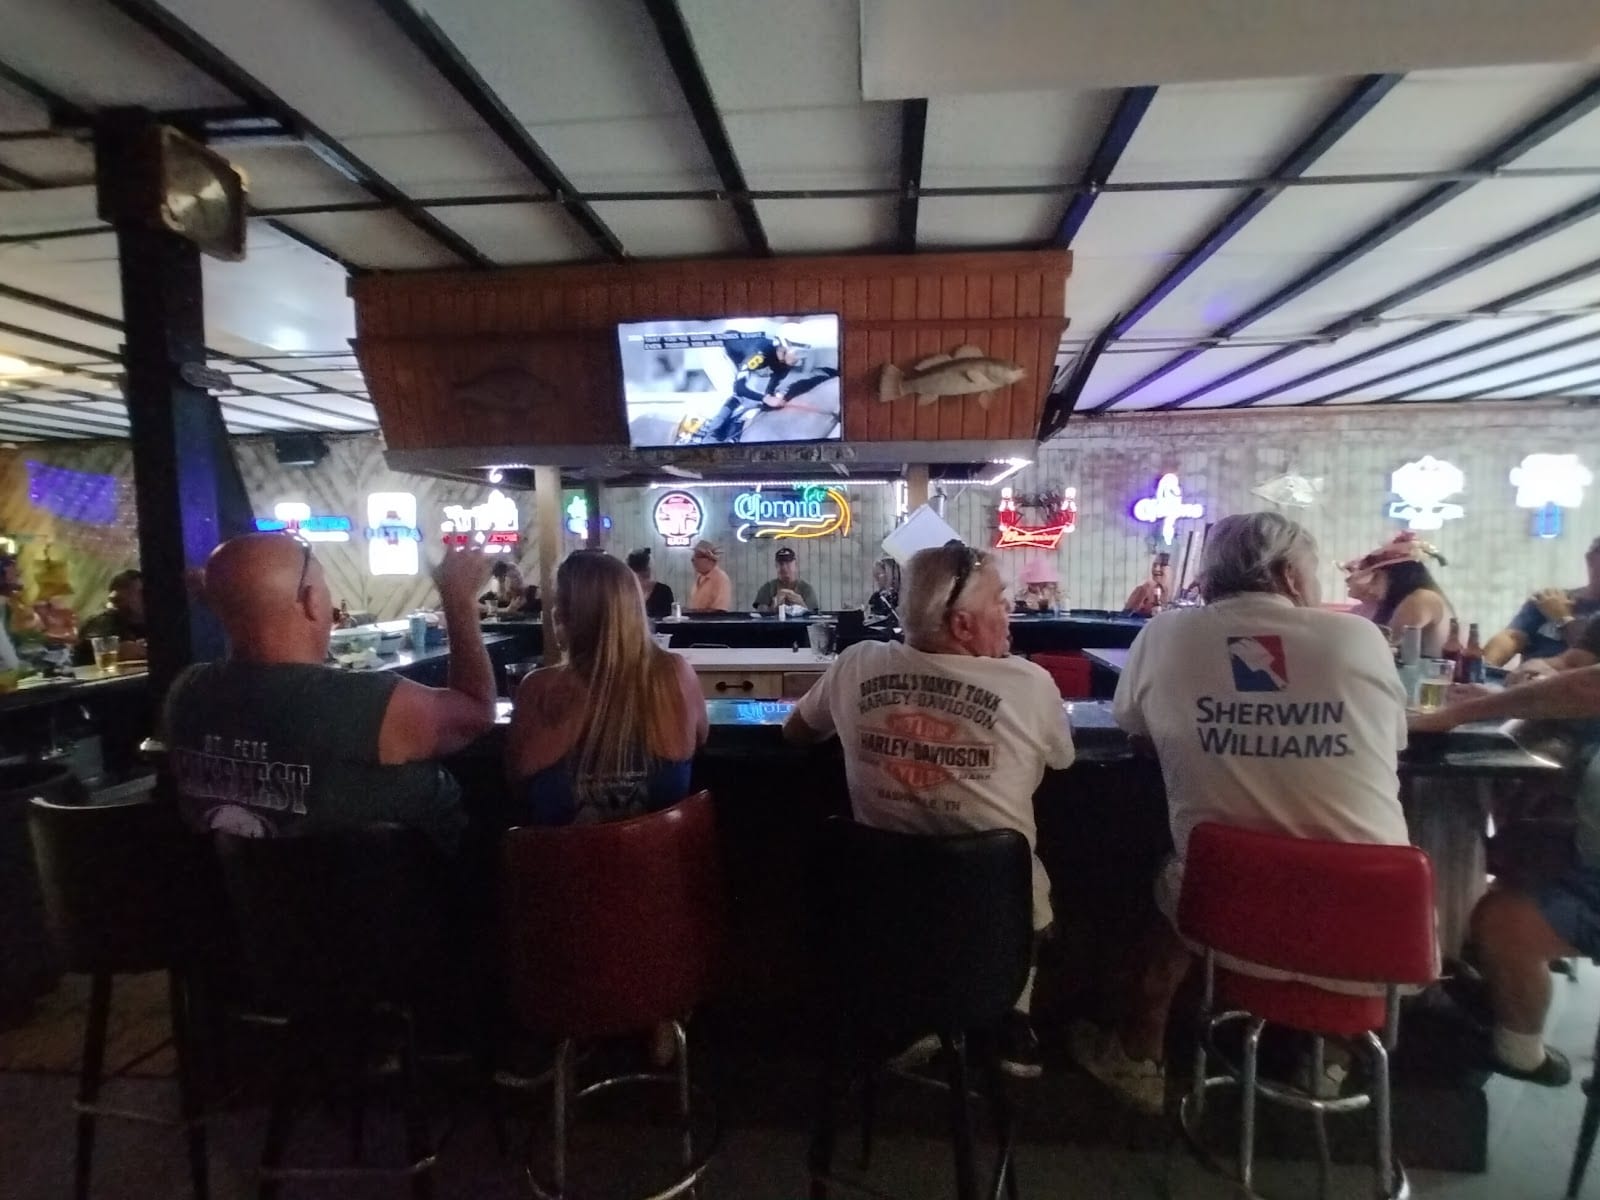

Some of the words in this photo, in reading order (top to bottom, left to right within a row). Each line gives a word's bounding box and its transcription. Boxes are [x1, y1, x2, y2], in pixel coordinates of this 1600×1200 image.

[735, 493, 821, 521] Corona
[1196, 697, 1344, 726] SHERWIN
[860, 733, 990, 767] HARLEY-DAVIDSON
